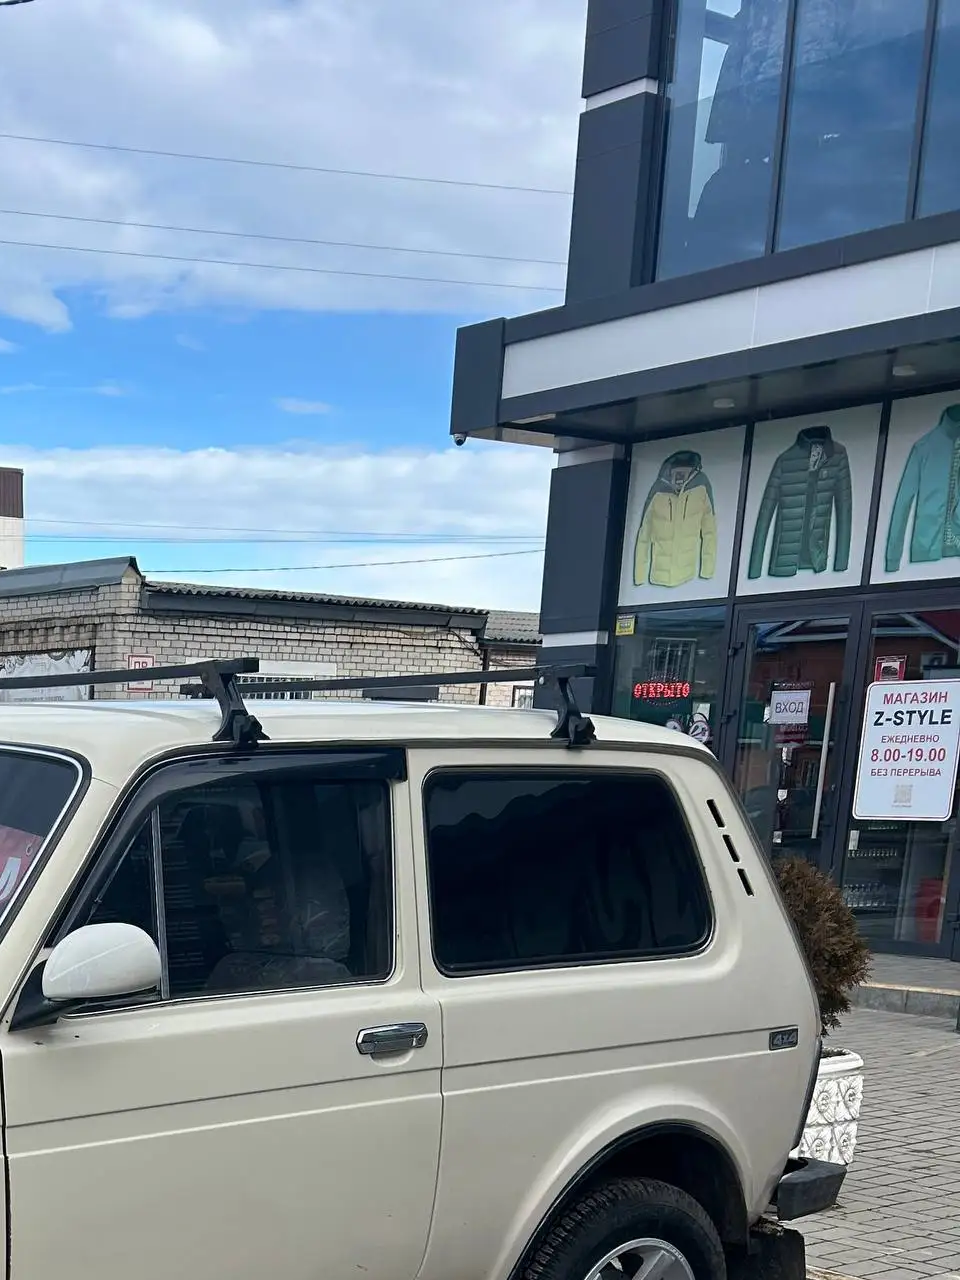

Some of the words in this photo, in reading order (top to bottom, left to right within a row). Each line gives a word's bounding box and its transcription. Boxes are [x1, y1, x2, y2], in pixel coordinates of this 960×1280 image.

[633, 682, 690, 698] ОТКРЫТО
[883, 691, 948, 705] МАГАЗИН
[775, 701, 804, 714] ВХОД
[873, 709, 953, 727] Z-STYLE
[881, 734, 940, 744] ЕЖЕДНЕВНО
[870, 747, 946, 763] 8.00-19.00
[870, 768, 888, 777] БЕЗ
[890, 767, 942, 777] ПЕРЕРЫВА
